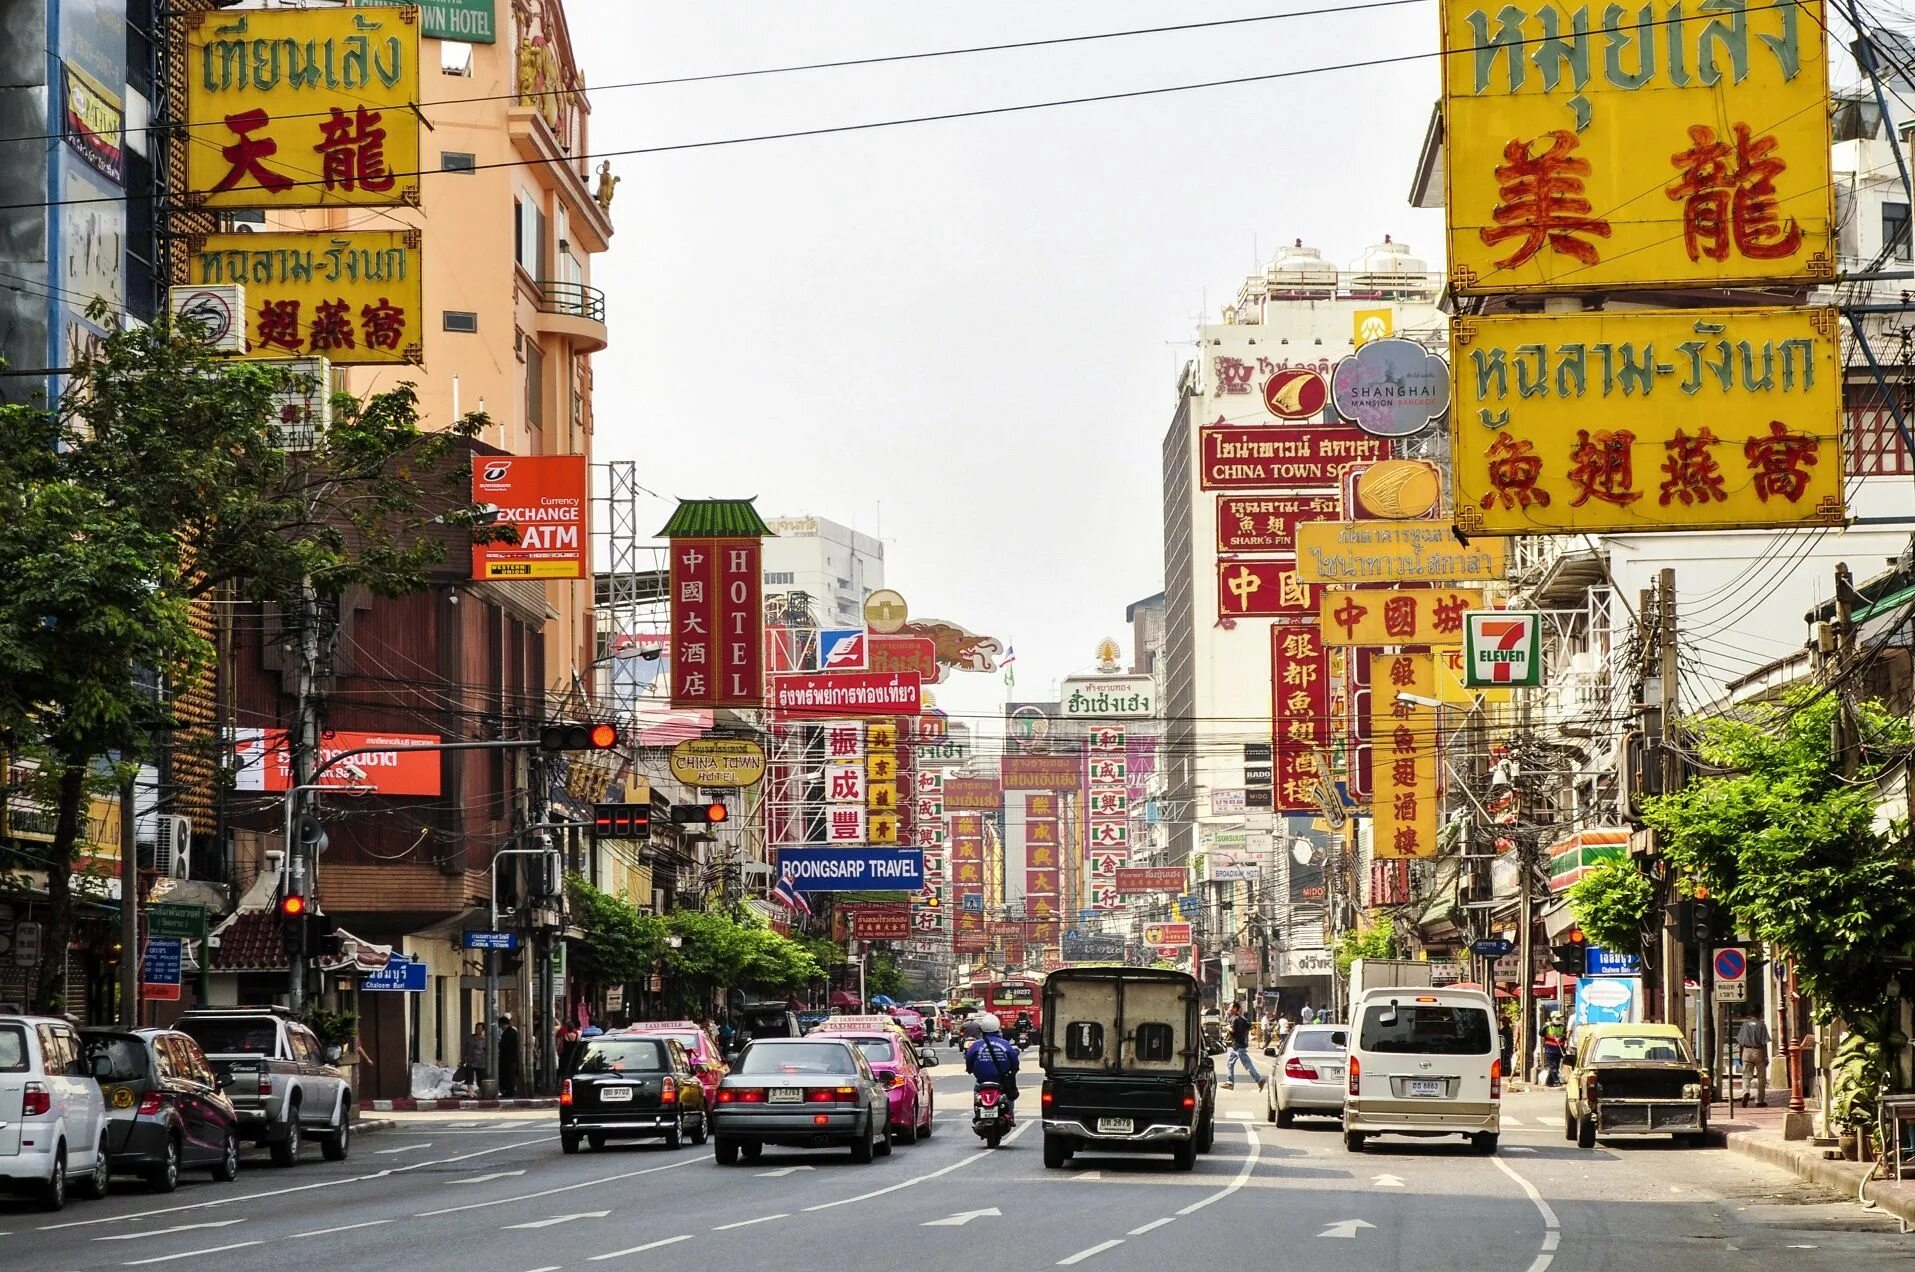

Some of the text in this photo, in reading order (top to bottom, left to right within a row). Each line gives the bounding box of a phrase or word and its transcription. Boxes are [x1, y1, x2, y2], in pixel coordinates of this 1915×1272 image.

[450, 9, 491, 35] HOTEL
[208, 104, 395, 194] 天龍
[1479, 121, 1801, 269] 美龍
[245, 297, 406, 351] 翅燕窩
[1351, 386, 1436, 397] SHANGHAI
[1351, 398, 1436, 407] MANSION BANGKOK
[1212, 464, 1267, 479] CHINA
[1270, 463, 1322, 479] TOWN
[1480, 421, 1819, 511] 魚翅燕窩
[540, 497, 580, 506] Currency
[497, 507, 579, 521] EXCHANGE
[521, 526, 578, 549] ATM
[1230, 536, 1291, 545] SHARK'S FIN
[681, 549, 707, 697] 中國大酒店
[729, 550, 748, 696] HOTEL
[1333, 594, 1469, 641] 中國城
[1481, 621, 1525, 681] 7
[675, 756, 760, 770] CHINA TOWN
[698, 772, 738, 782] HOTEL
[829, 727, 860, 840] 振成豐
[1099, 732, 1119, 907] 和成興大金行
[782, 859, 919, 878] ROONGSARP TRAVEL
[1302, 888, 1324, 897] MIDO
[1501, 942, 1507, 950] 2
[365, 981, 405, 989] Chaloem Buri
[828, 1022, 872, 1030] TAXI-METER
